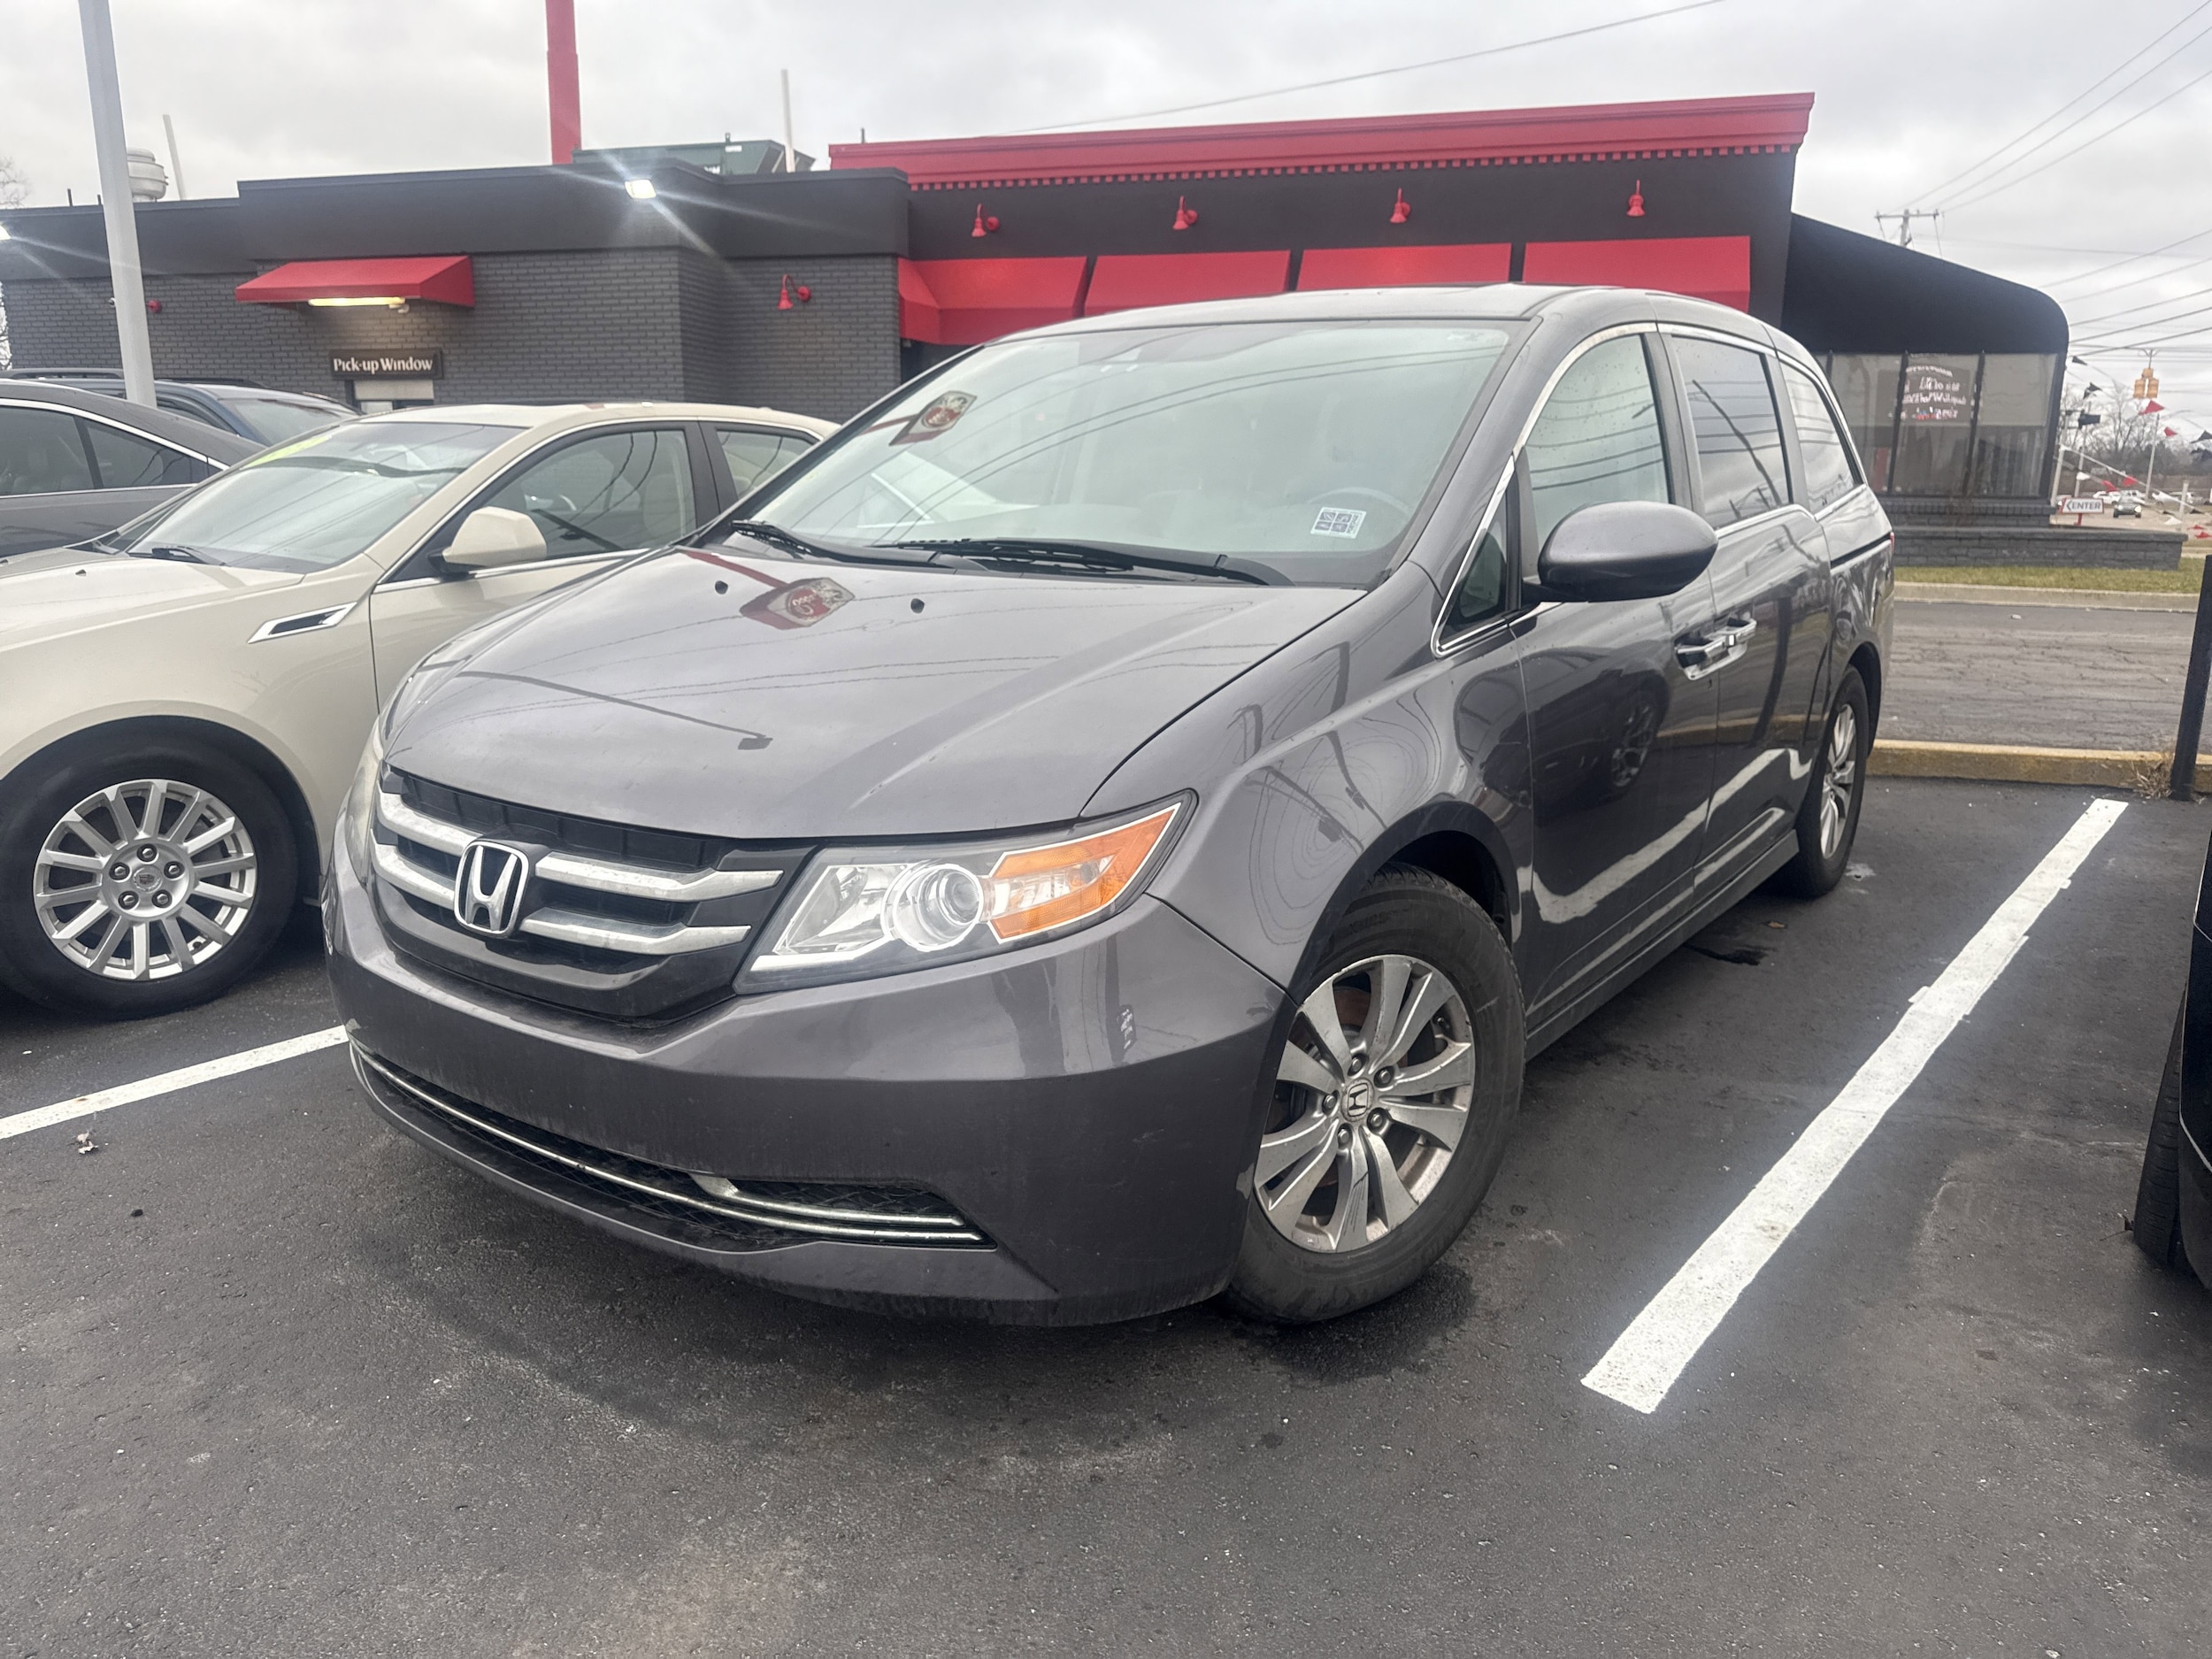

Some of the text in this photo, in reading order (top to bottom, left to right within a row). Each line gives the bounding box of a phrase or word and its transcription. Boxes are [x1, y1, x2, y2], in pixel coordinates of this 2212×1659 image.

[333, 356, 433, 374] Pick-up Window
[2071, 501, 2101, 511] ENTER
